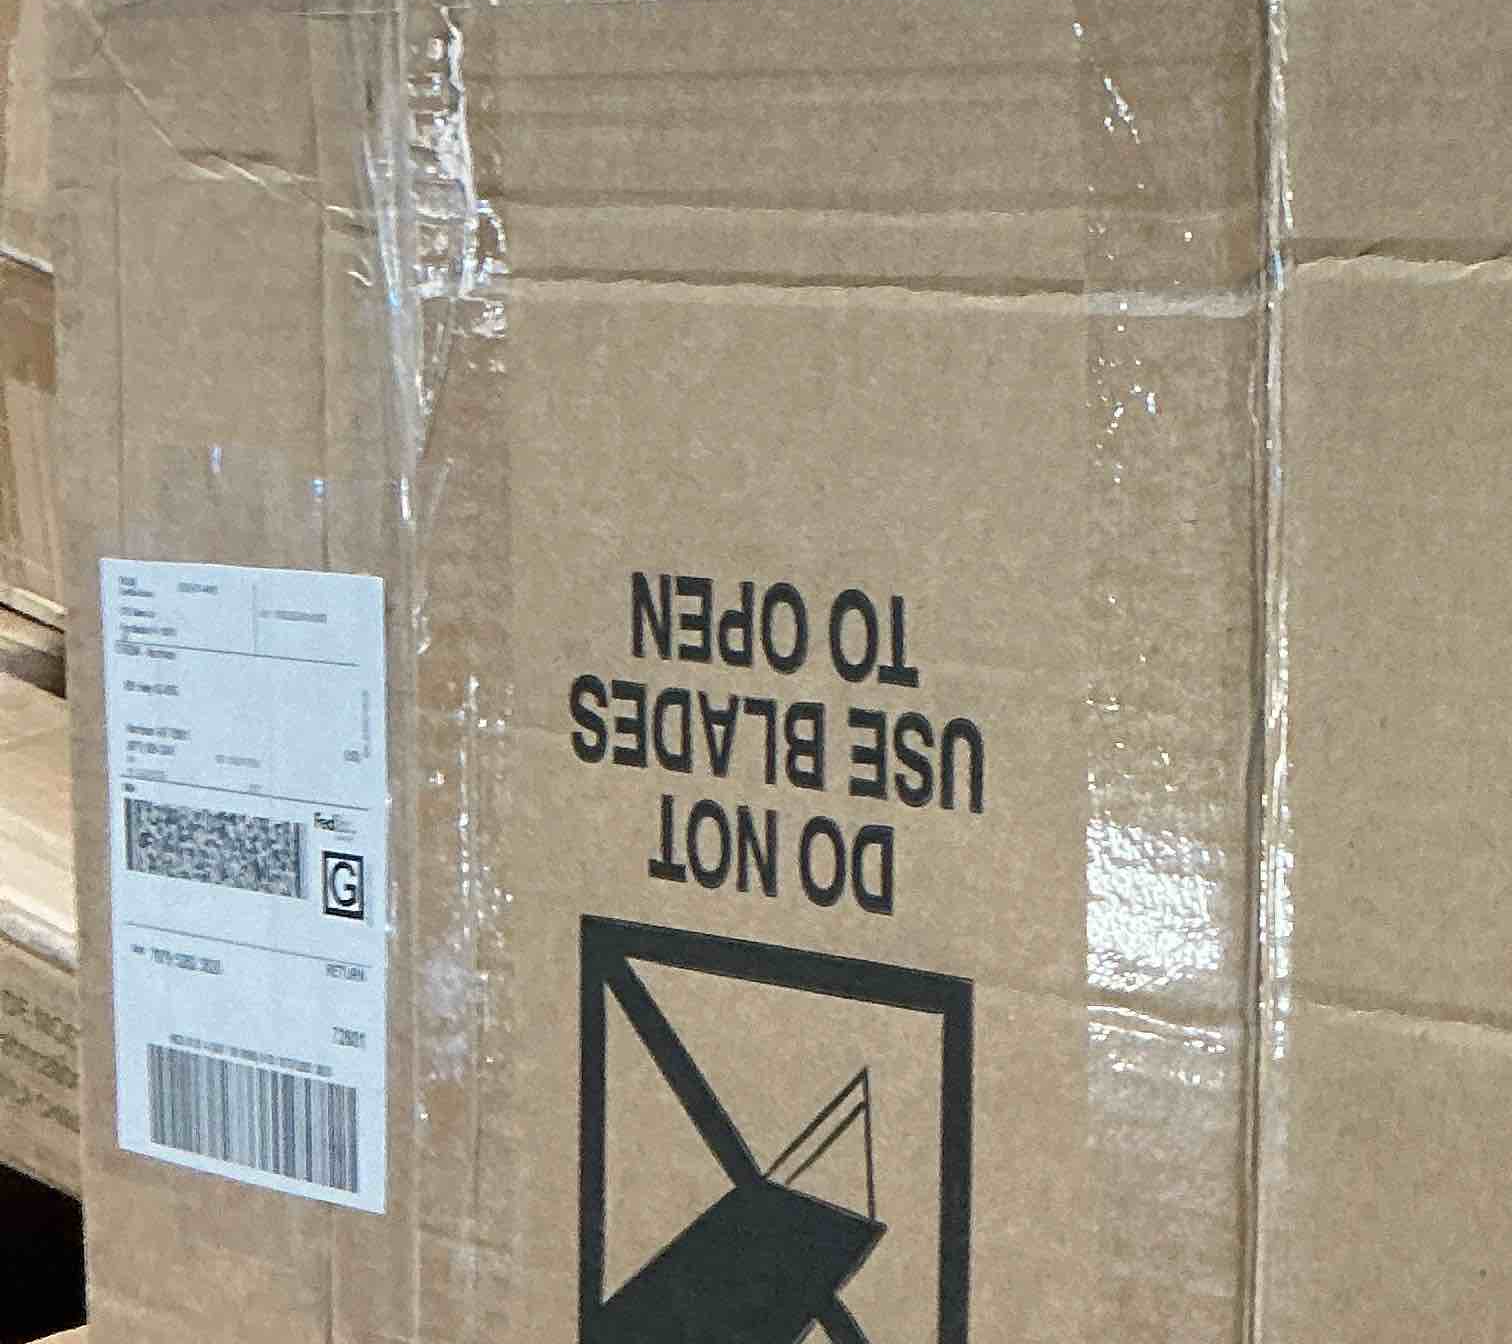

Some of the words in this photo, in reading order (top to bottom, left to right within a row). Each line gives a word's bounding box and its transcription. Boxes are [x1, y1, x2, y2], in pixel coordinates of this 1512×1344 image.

[630, 571, 808, 674] OPEN
[829, 588, 920, 688] TO
[569, 674, 825, 791] BLADES
[848, 707, 984, 814] USE
[331, 860, 357, 908] G
[648, 793, 778, 897] NOT
[799, 815, 894, 916] DO
